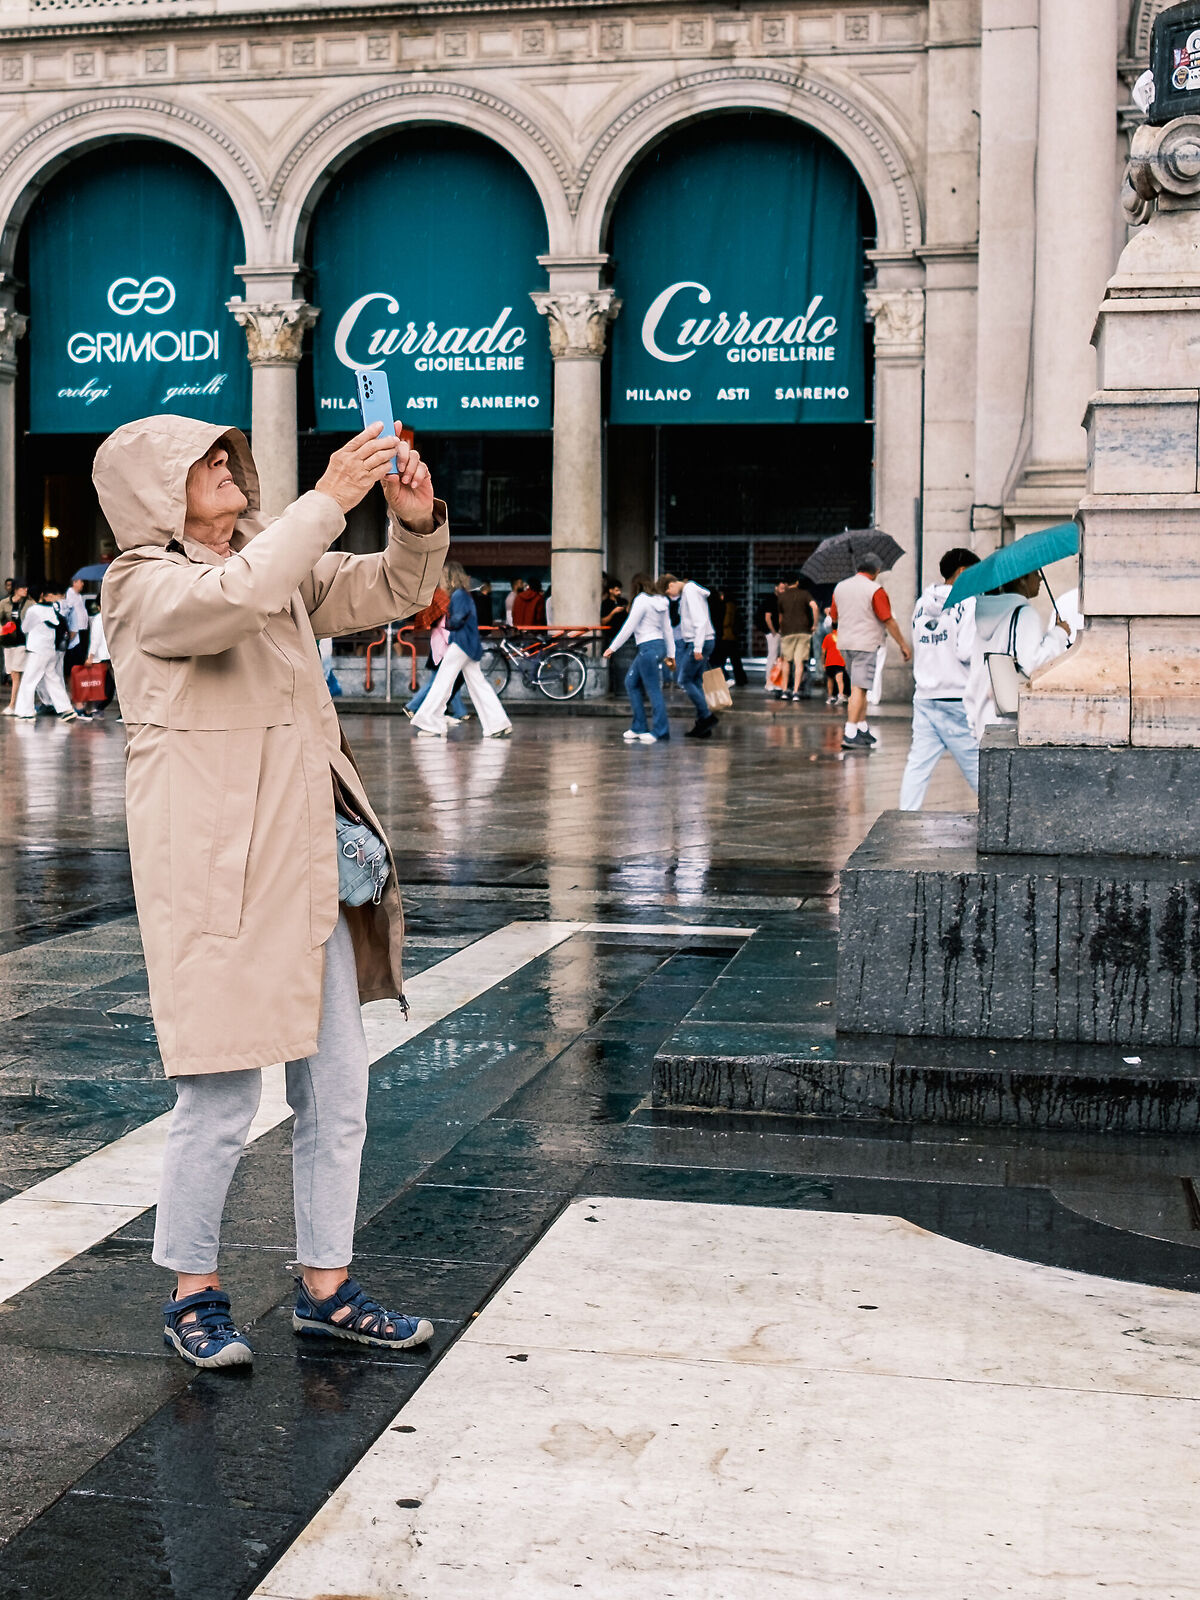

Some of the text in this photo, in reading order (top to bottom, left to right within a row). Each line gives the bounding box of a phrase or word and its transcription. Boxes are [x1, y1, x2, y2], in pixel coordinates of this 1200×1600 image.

[334, 292, 527, 371] Currado
[641, 281, 838, 363] Currado
[67, 329, 220, 364] GRIMOLDI
[726, 346, 836, 363] GIOIELLERIE
[414, 356, 525, 372] GIOIELLERIE
[57, 373, 228, 406] orologi gioielli
[626, 387, 850, 401] MILANO ASTI SANREMO
[321, 395, 540, 410] MILA ASTI SANREMO
